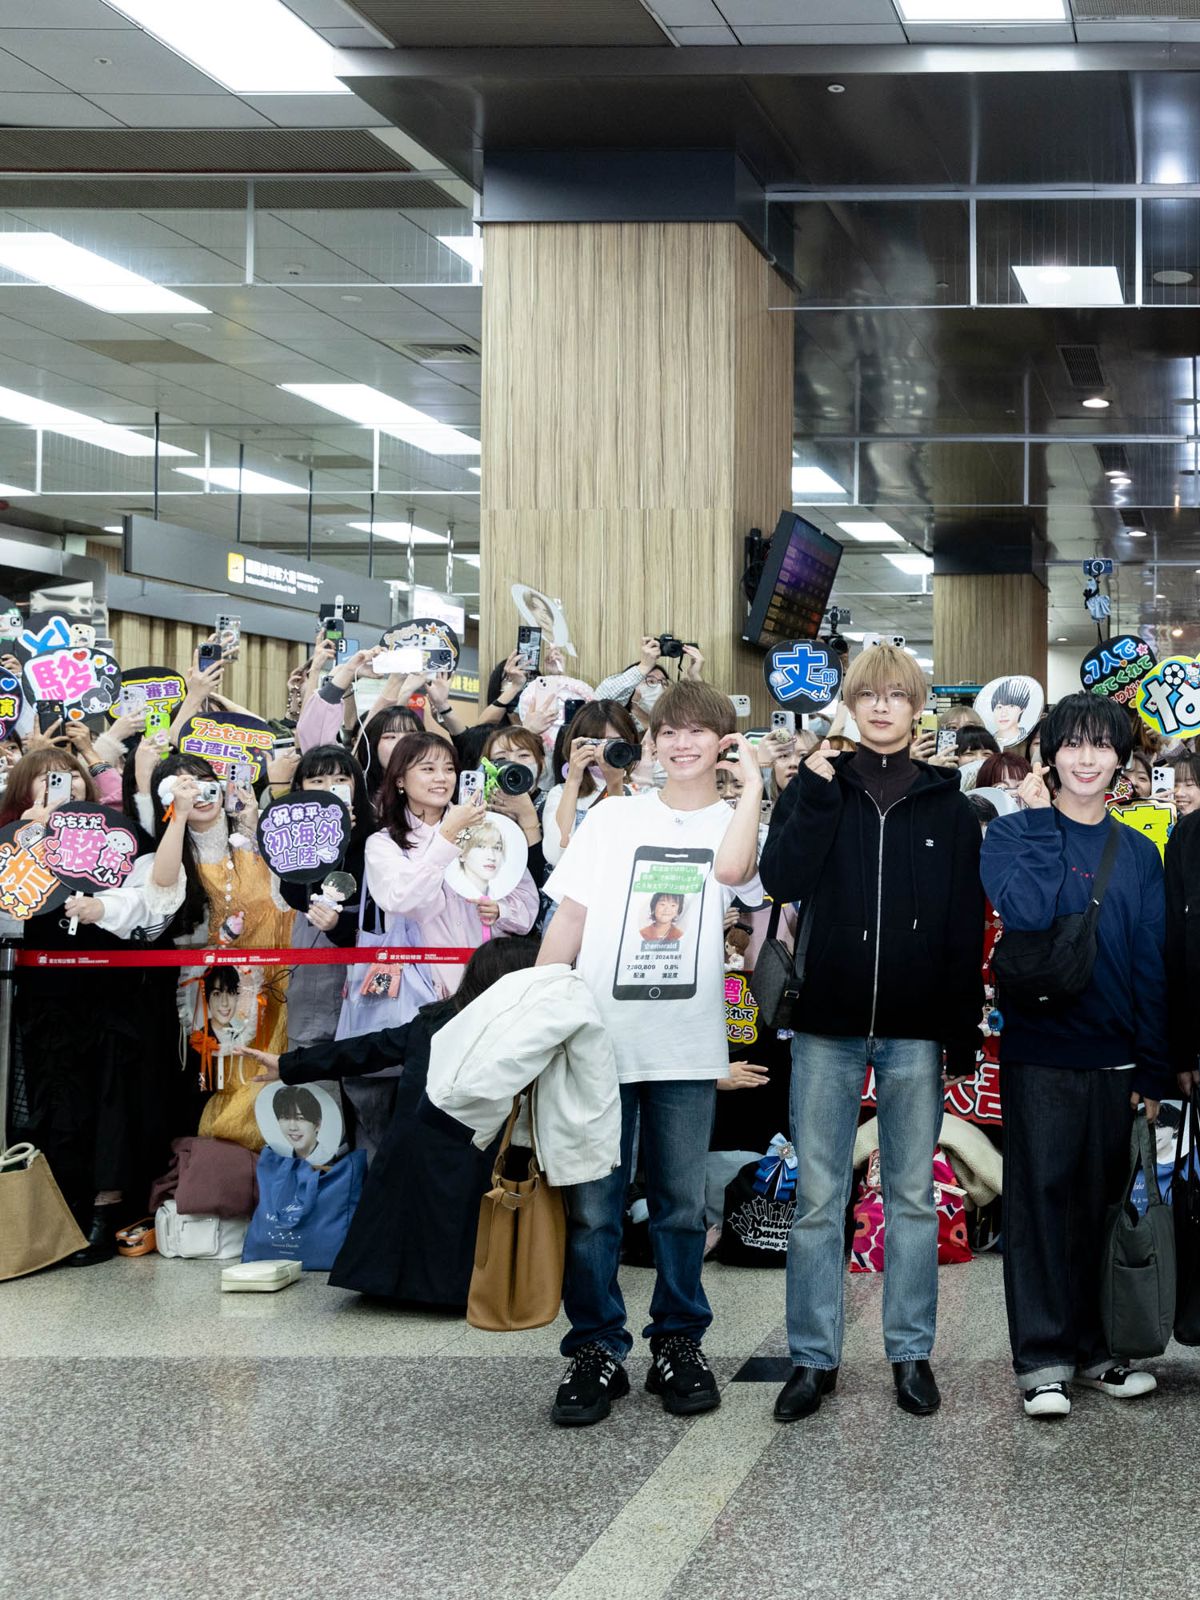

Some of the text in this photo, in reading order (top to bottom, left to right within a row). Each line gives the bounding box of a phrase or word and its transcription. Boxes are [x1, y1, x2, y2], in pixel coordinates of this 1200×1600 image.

[1084, 638, 1137, 679] 7人で
[53, 814, 102, 830] みちえだ
[267, 821, 341, 855] 初海外
[279, 846, 317, 870] 上陸
[92, 866, 118, 885] くん
[748, 1214, 794, 1230] Naniw
